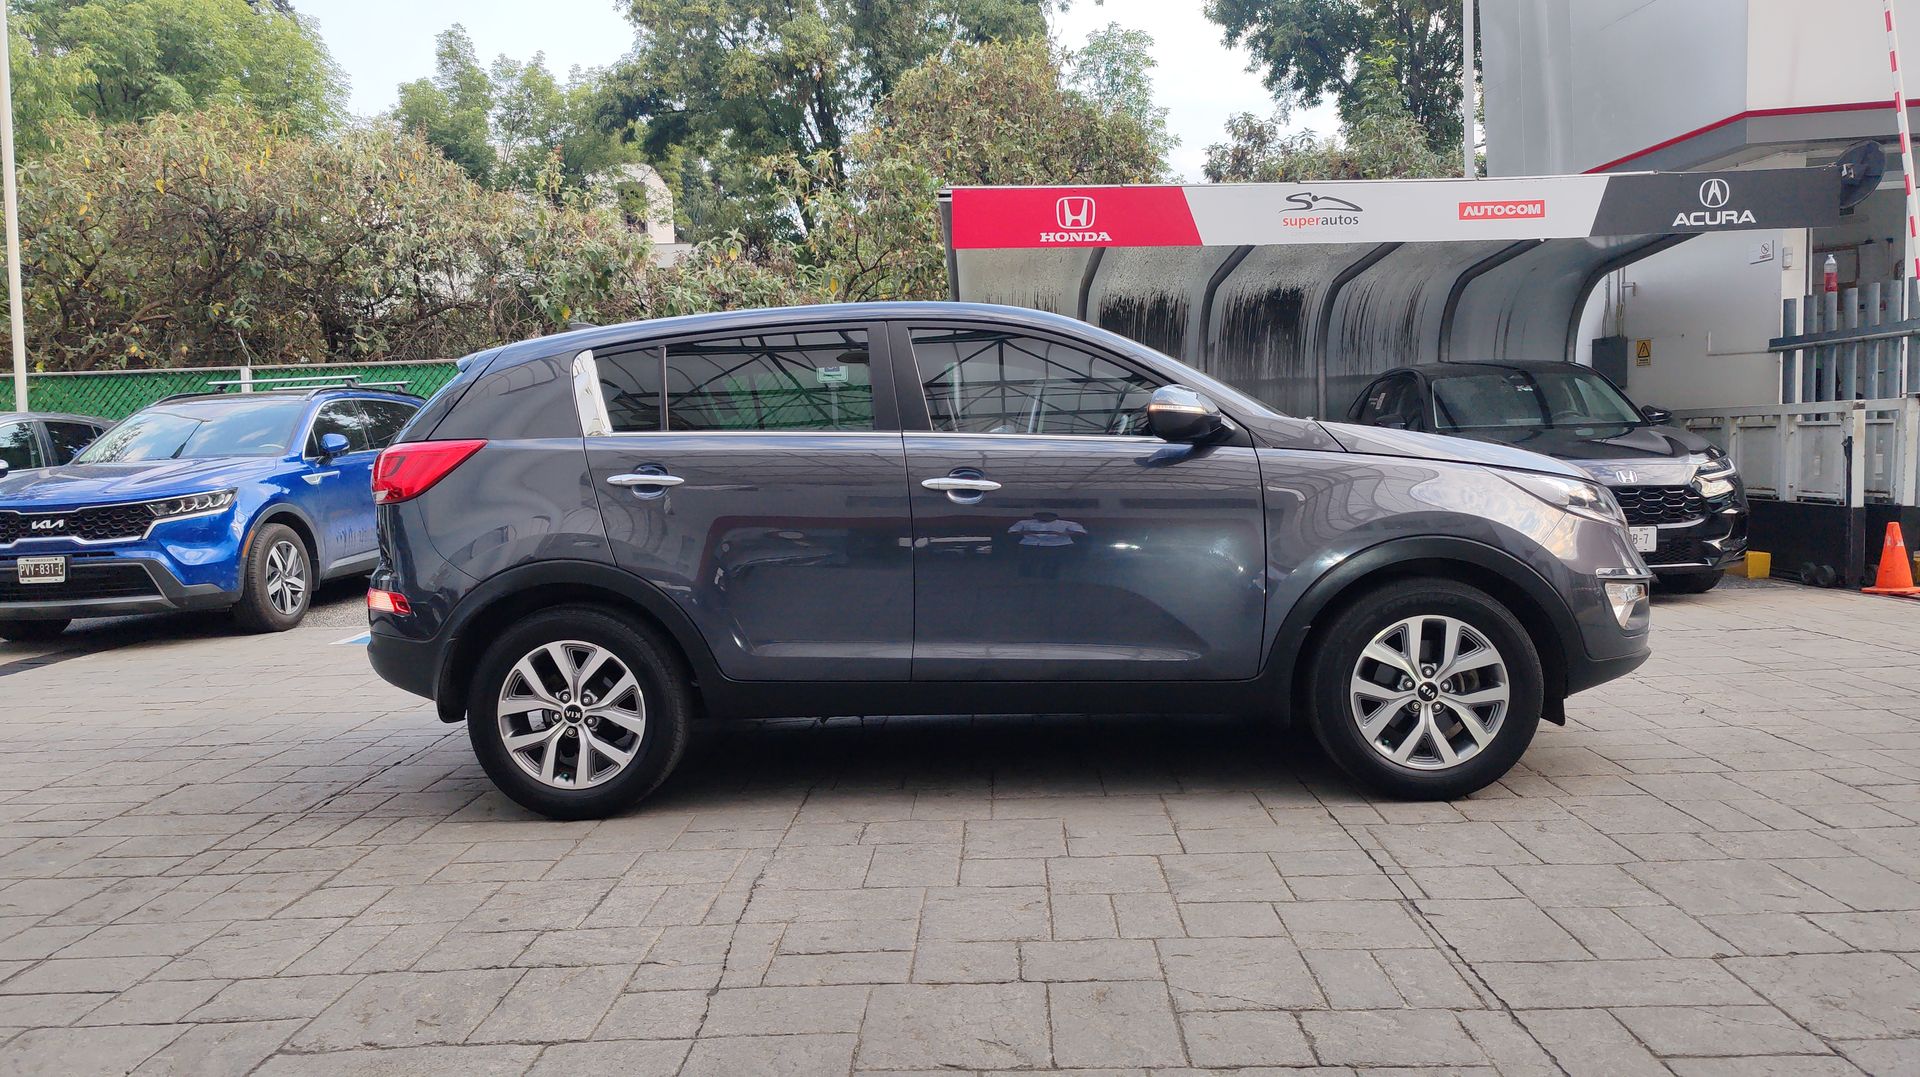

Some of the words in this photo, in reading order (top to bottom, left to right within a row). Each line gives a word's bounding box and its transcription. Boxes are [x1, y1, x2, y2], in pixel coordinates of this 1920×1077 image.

[1463, 203, 1541, 217] AUTOCOM
[1282, 214, 1359, 228] superautos
[1672, 209, 1757, 227] ACURA
[1040, 231, 1112, 242] HONDA
[31, 519, 64, 530] KIA
[19, 562, 64, 576] PVY-831-E
[1420, 684, 1437, 699] KIA
[564, 709, 582, 719] KIA
